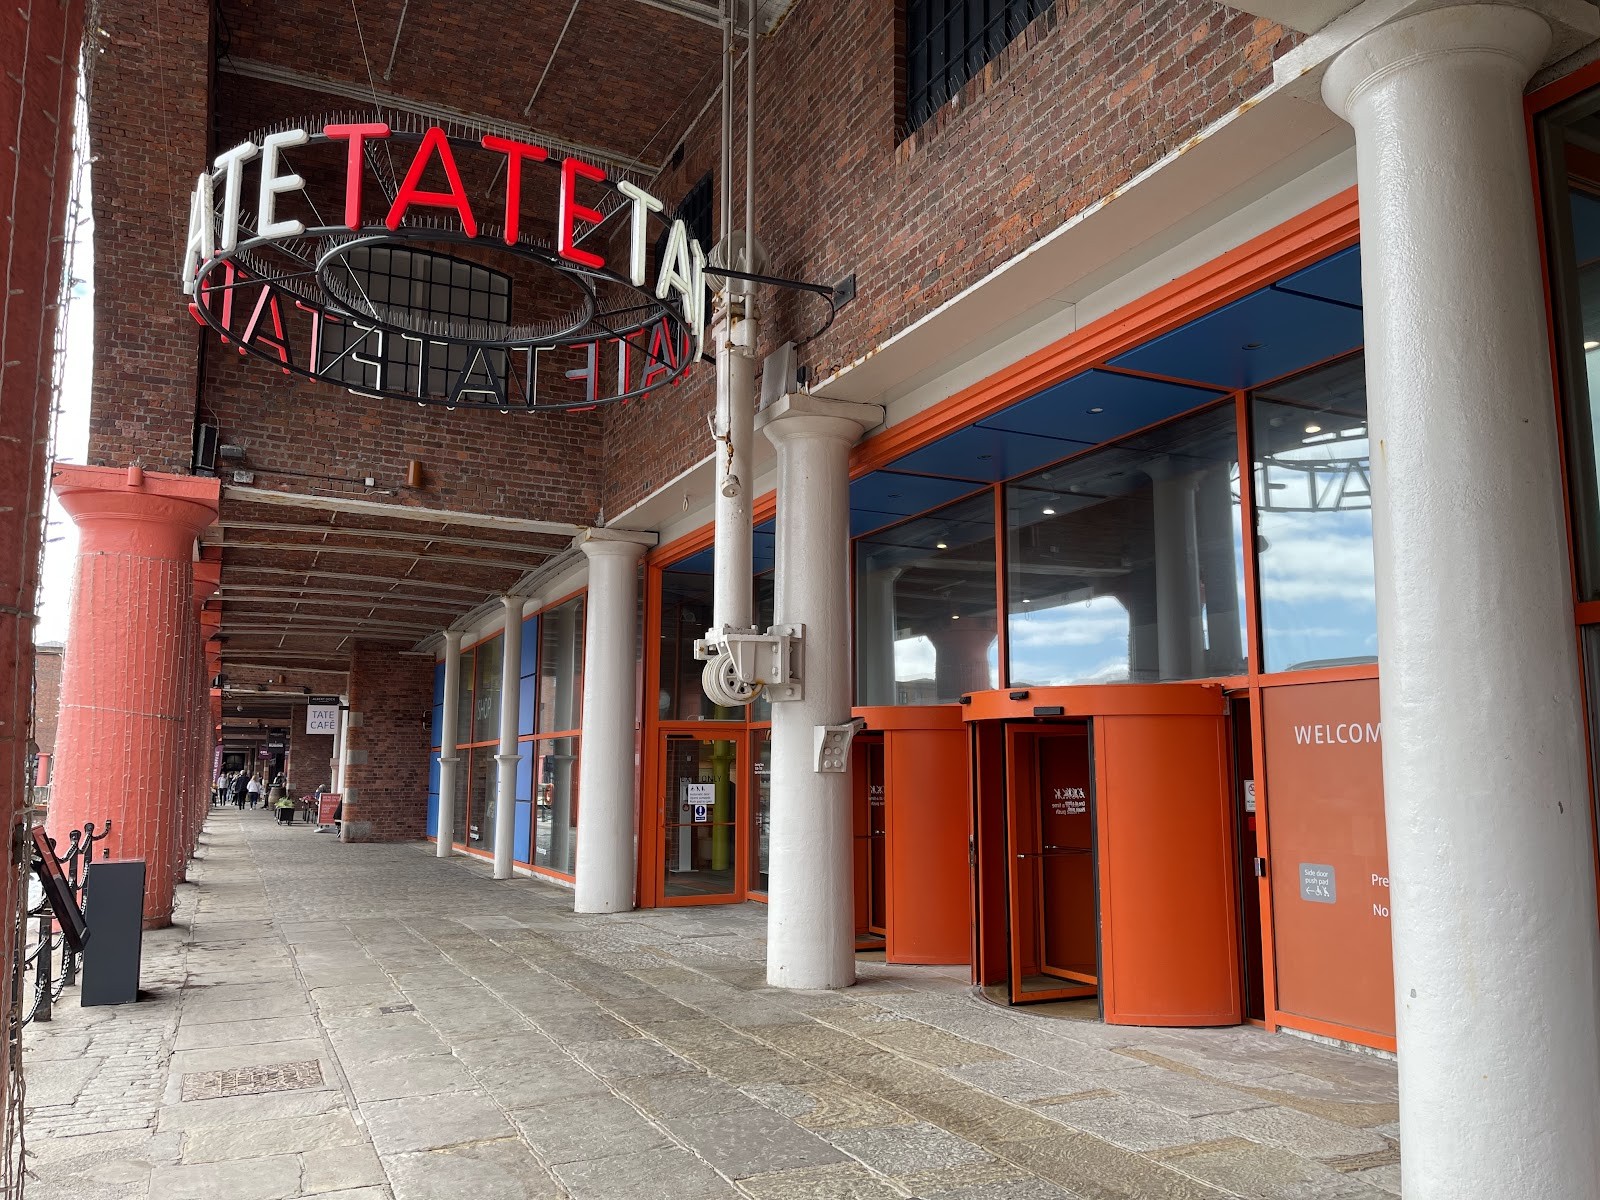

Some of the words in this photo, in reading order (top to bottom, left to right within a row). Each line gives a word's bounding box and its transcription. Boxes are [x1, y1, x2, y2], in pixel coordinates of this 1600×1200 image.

[323, 123, 606, 268] TATE
[183, 129, 309, 295] ATE
[477, 697, 492, 721] SHOP
[312, 711, 335, 719] TATE
[310, 720, 335, 730] CAFÉ
[701, 775, 722, 783] ONLY
[1304, 869, 1316, 877] Side
[1316, 869, 1329, 877] door
[1318, 879, 1329, 887] pad
[1373, 903, 1389, 917] No
